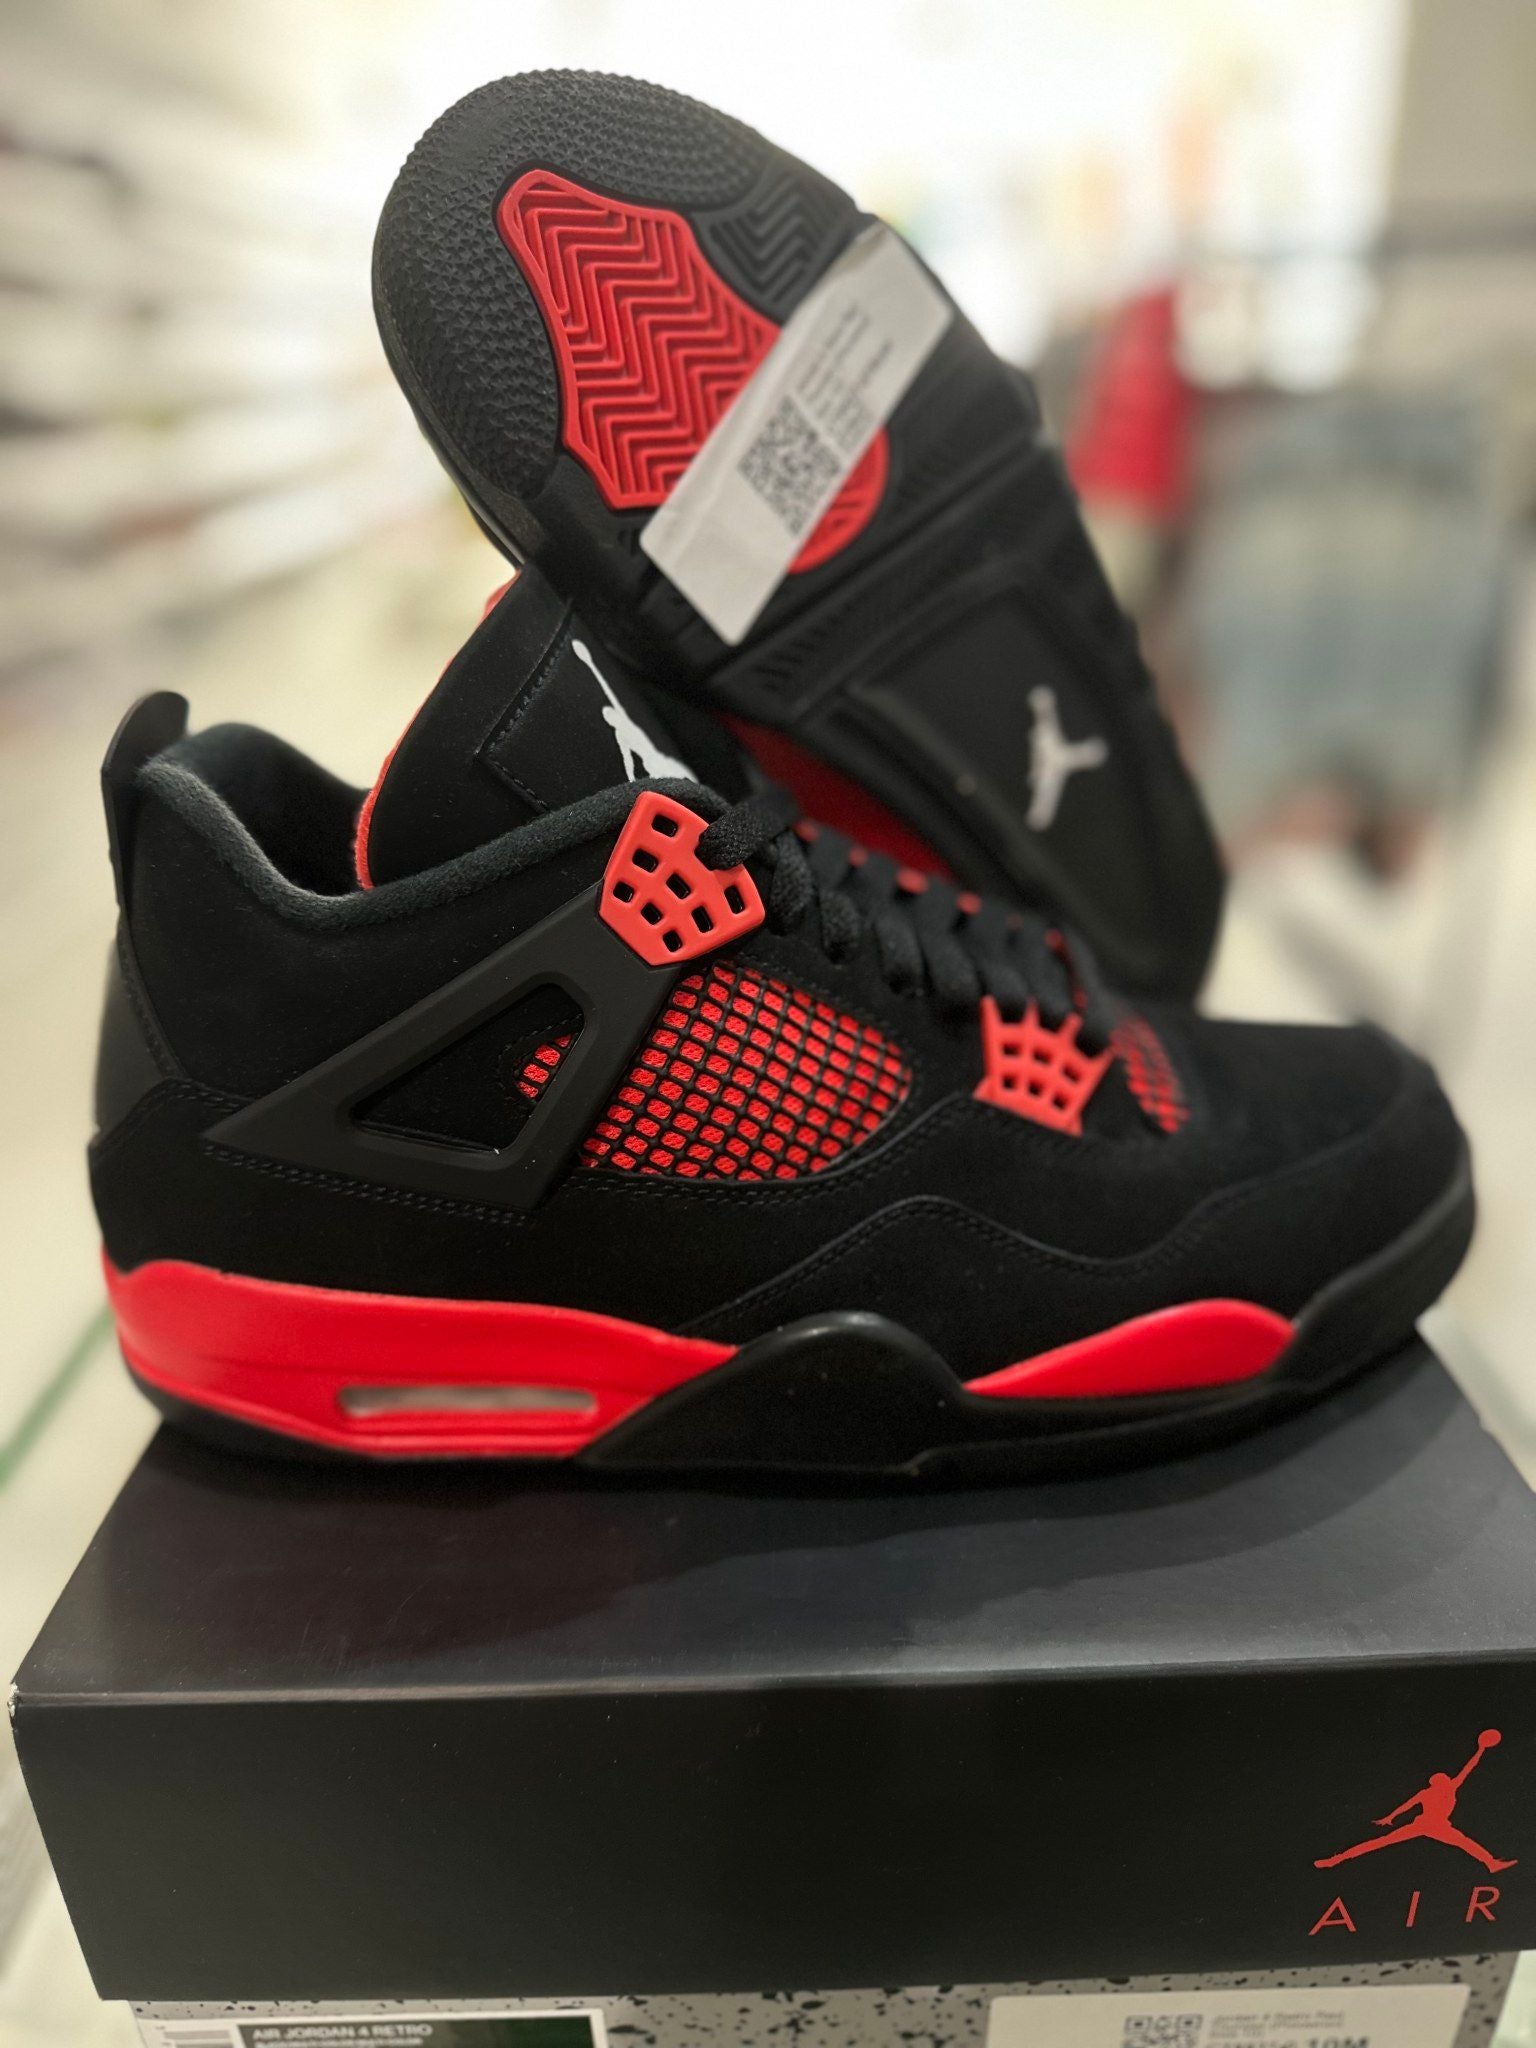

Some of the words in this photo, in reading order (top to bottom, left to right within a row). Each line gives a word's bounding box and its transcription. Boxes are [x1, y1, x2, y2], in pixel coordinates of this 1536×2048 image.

[1308, 1886, 1500, 1936] AIR
[252, 2028, 281, 2040] AIR
[283, 2026, 355, 2040] JORDAN
[372, 2023, 433, 2038] RETRO
